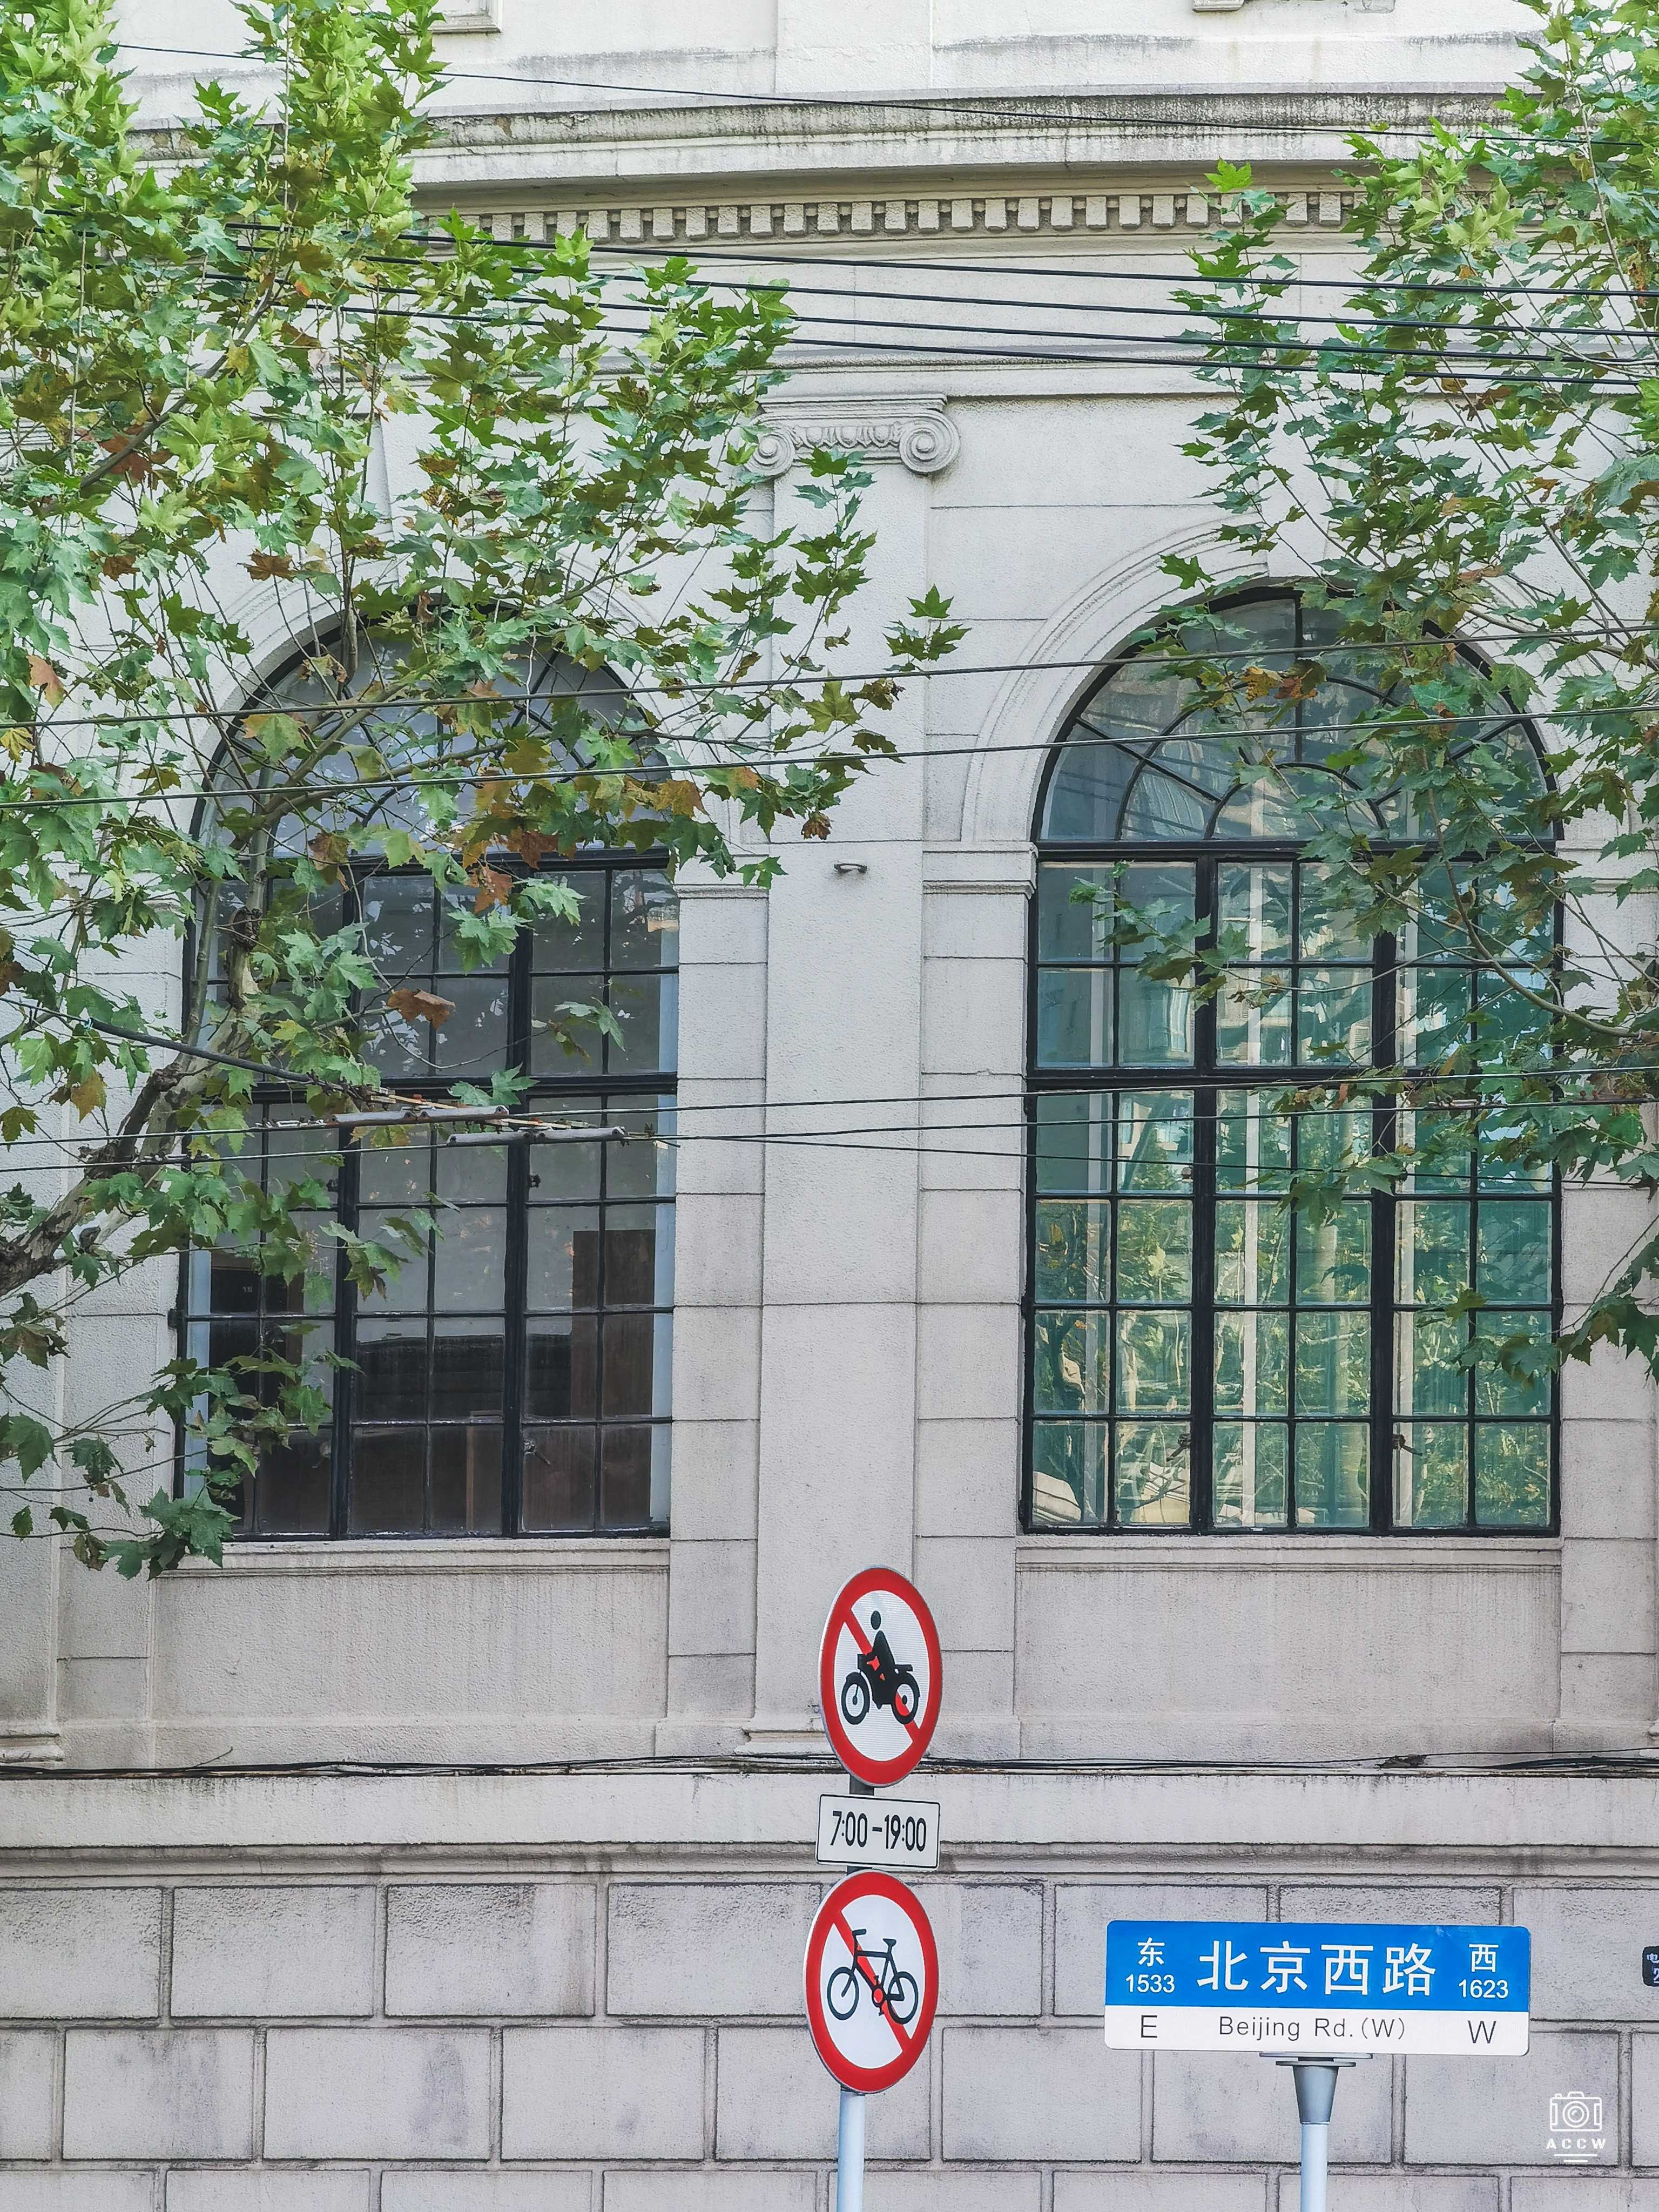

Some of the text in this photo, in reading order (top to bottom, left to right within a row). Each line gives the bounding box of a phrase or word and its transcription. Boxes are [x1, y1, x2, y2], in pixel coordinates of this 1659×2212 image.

[1137, 1937, 1165, 1967] 东
[1468, 1944, 1499, 1973] 西
[1196, 1940, 1437, 1996] 北京西路
[1125, 1974, 1175, 1993] 1533
[1458, 1979, 1509, 1998] 1623
[1141, 2015, 1158, 2038] E
[1219, 2016, 1300, 2041] Beijing
[1467, 2020, 1497, 2044] W
